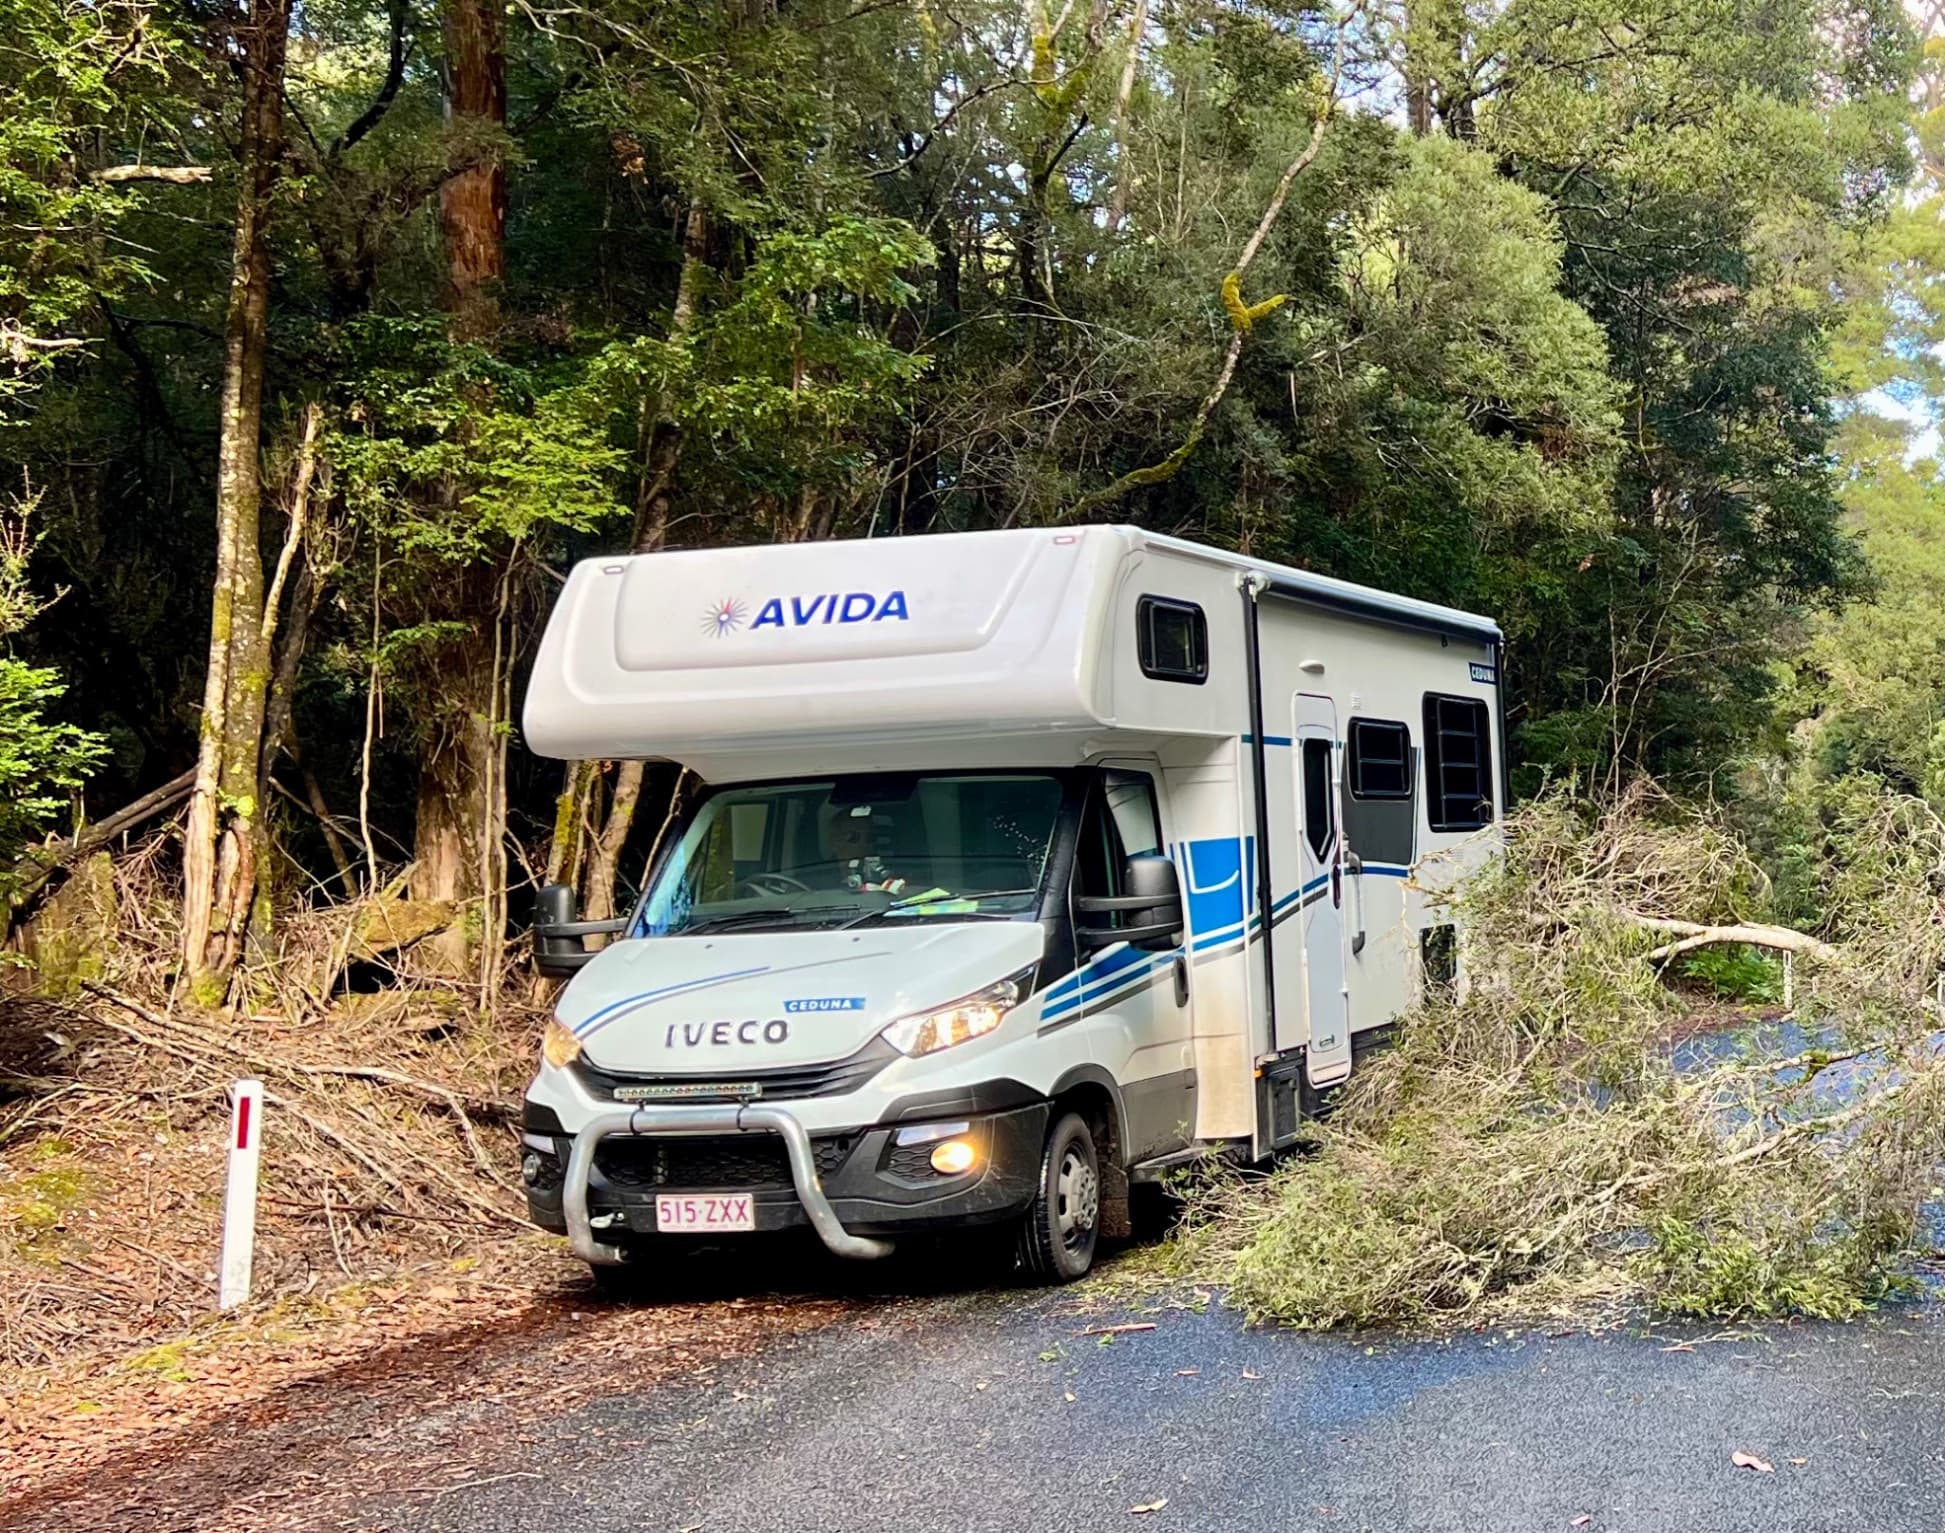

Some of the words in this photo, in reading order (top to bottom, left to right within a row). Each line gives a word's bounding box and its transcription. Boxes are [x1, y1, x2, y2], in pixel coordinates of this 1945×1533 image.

[750, 591, 909, 629] AVIDA
[788, 999, 852, 1011] CEDUNA
[665, 1020, 789, 1048] IVECO
